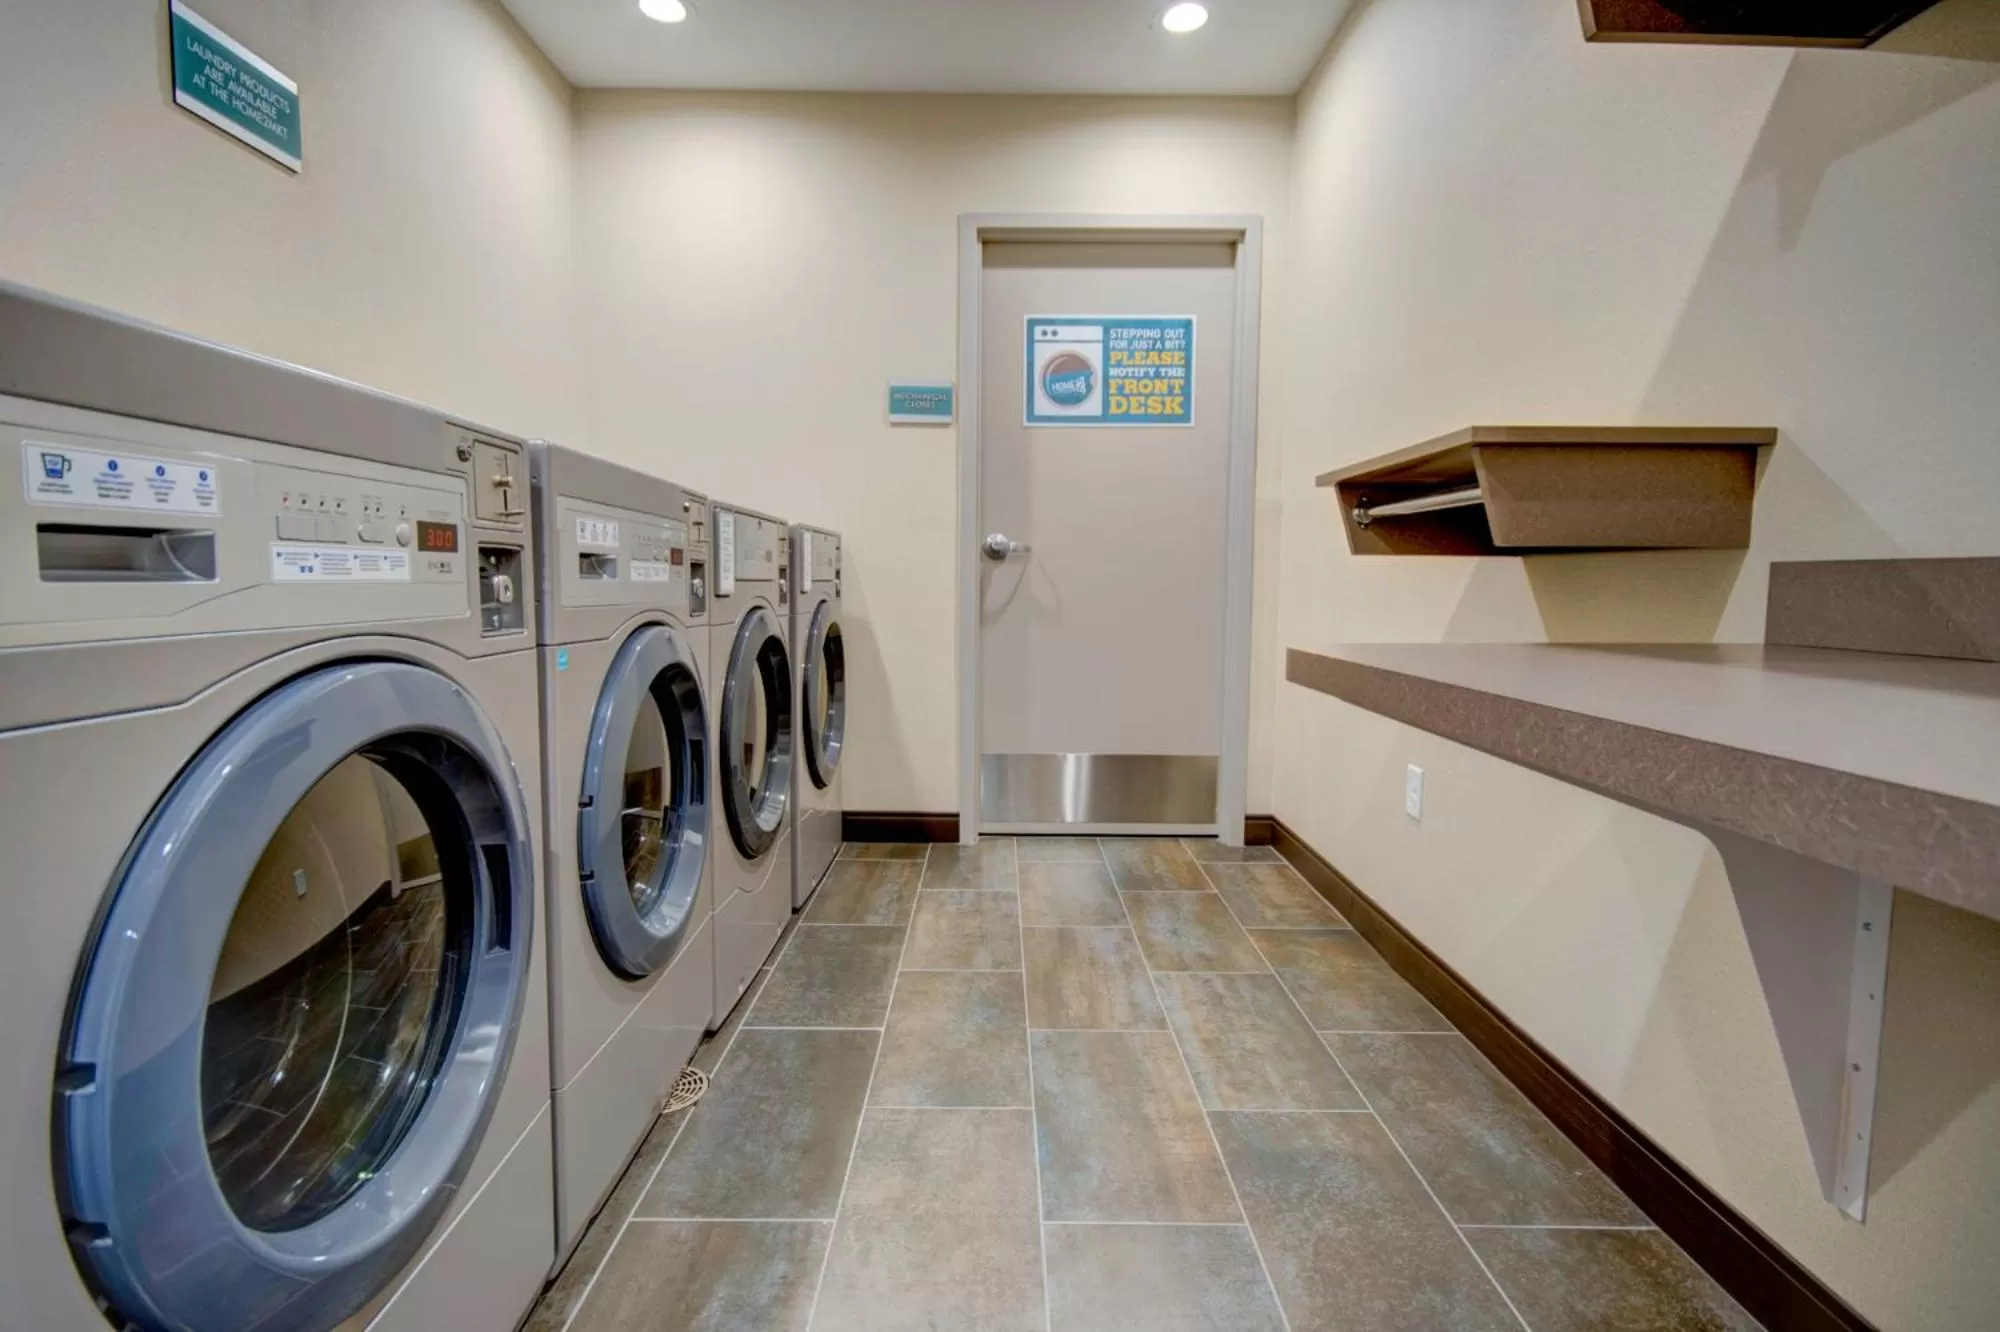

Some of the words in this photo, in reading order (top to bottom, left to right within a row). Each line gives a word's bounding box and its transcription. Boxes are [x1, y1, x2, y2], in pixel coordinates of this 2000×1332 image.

[186, 35, 237, 78] LAUNDRY
[240, 71, 291, 115] PRODUCTS
[192, 73, 206, 89] AT
[208, 81, 230, 105] THE
[204, 63, 225, 87] ARE
[228, 79, 278, 120] AVAILABLE
[1109, 327, 1161, 339] STEPPING
[1163, 327, 1185, 339] OUT
[1109, 339, 1129, 349] FOR
[1130, 339, 1153, 349] JUST
[1154, 340, 1163, 349] A
[1109, 351, 1185, 366] PLEASE
[1108, 367, 1156, 378] NOTIFY
[1158, 367, 1185, 378] THE
[1108, 378, 1185, 395] FRONT
[1108, 396, 1185, 416] DESK
[427, 527, 453, 547] 300
